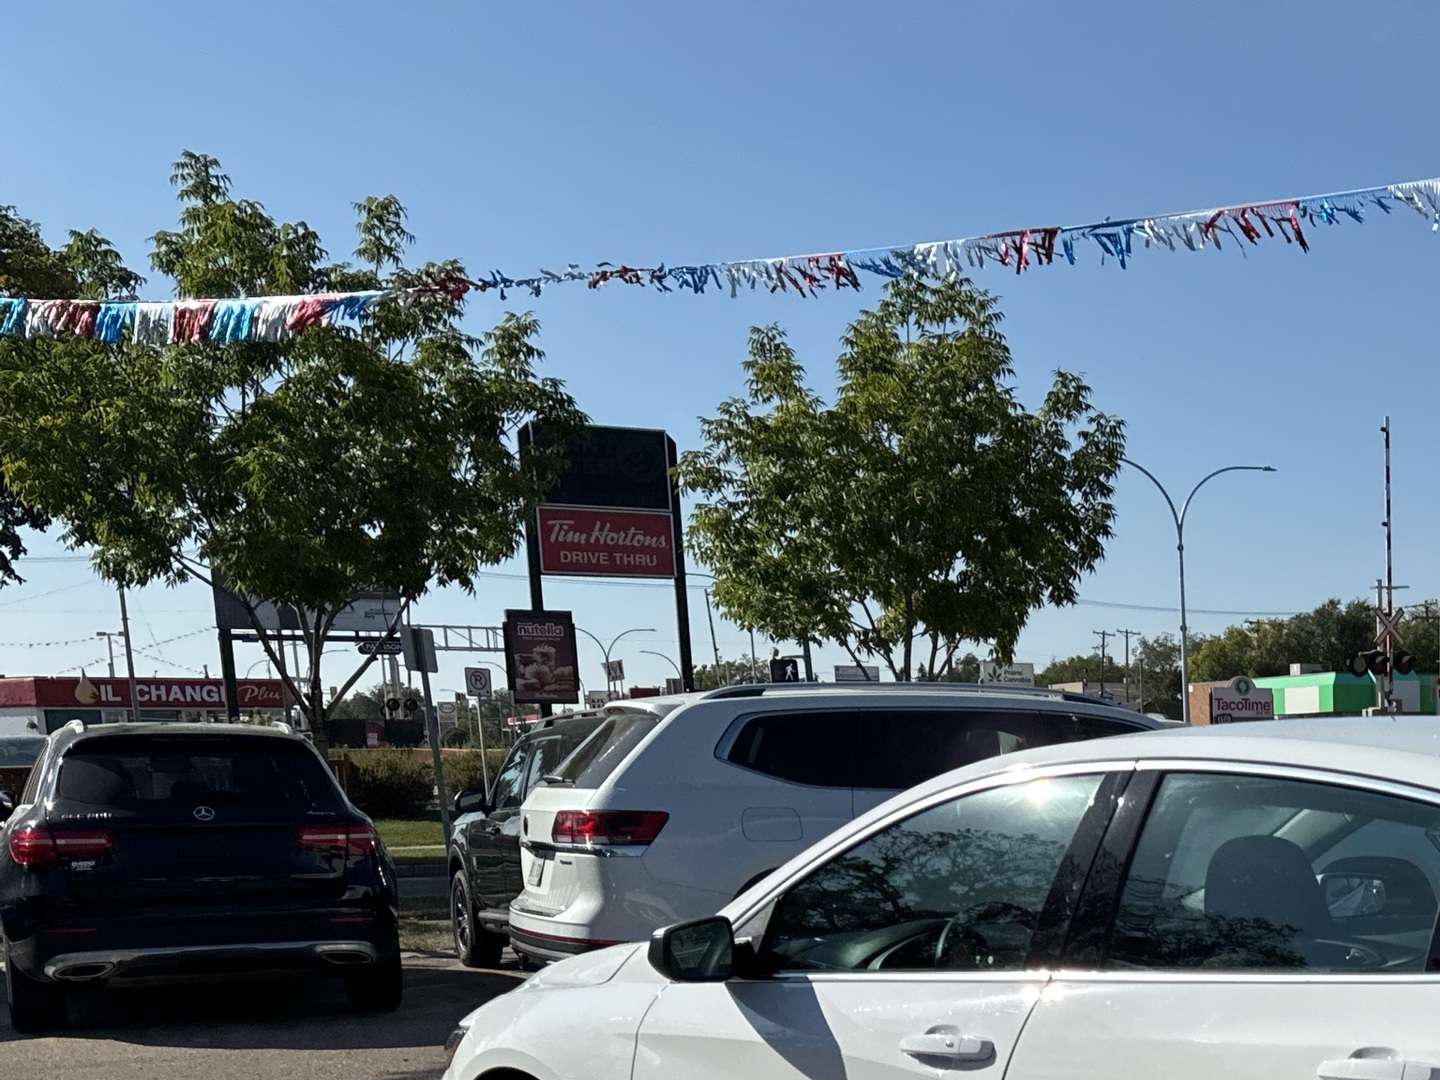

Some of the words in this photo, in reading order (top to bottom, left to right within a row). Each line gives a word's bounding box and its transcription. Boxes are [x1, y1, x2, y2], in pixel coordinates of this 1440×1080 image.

[547, 519, 586, 545] Tim
[590, 521, 667, 549] Hortons
[560, 551, 609, 564] DRIVE
[613, 553, 657, 566] THRU
[517, 622, 564, 637] nutella
[1214, 698, 1271, 711] TacoTime
